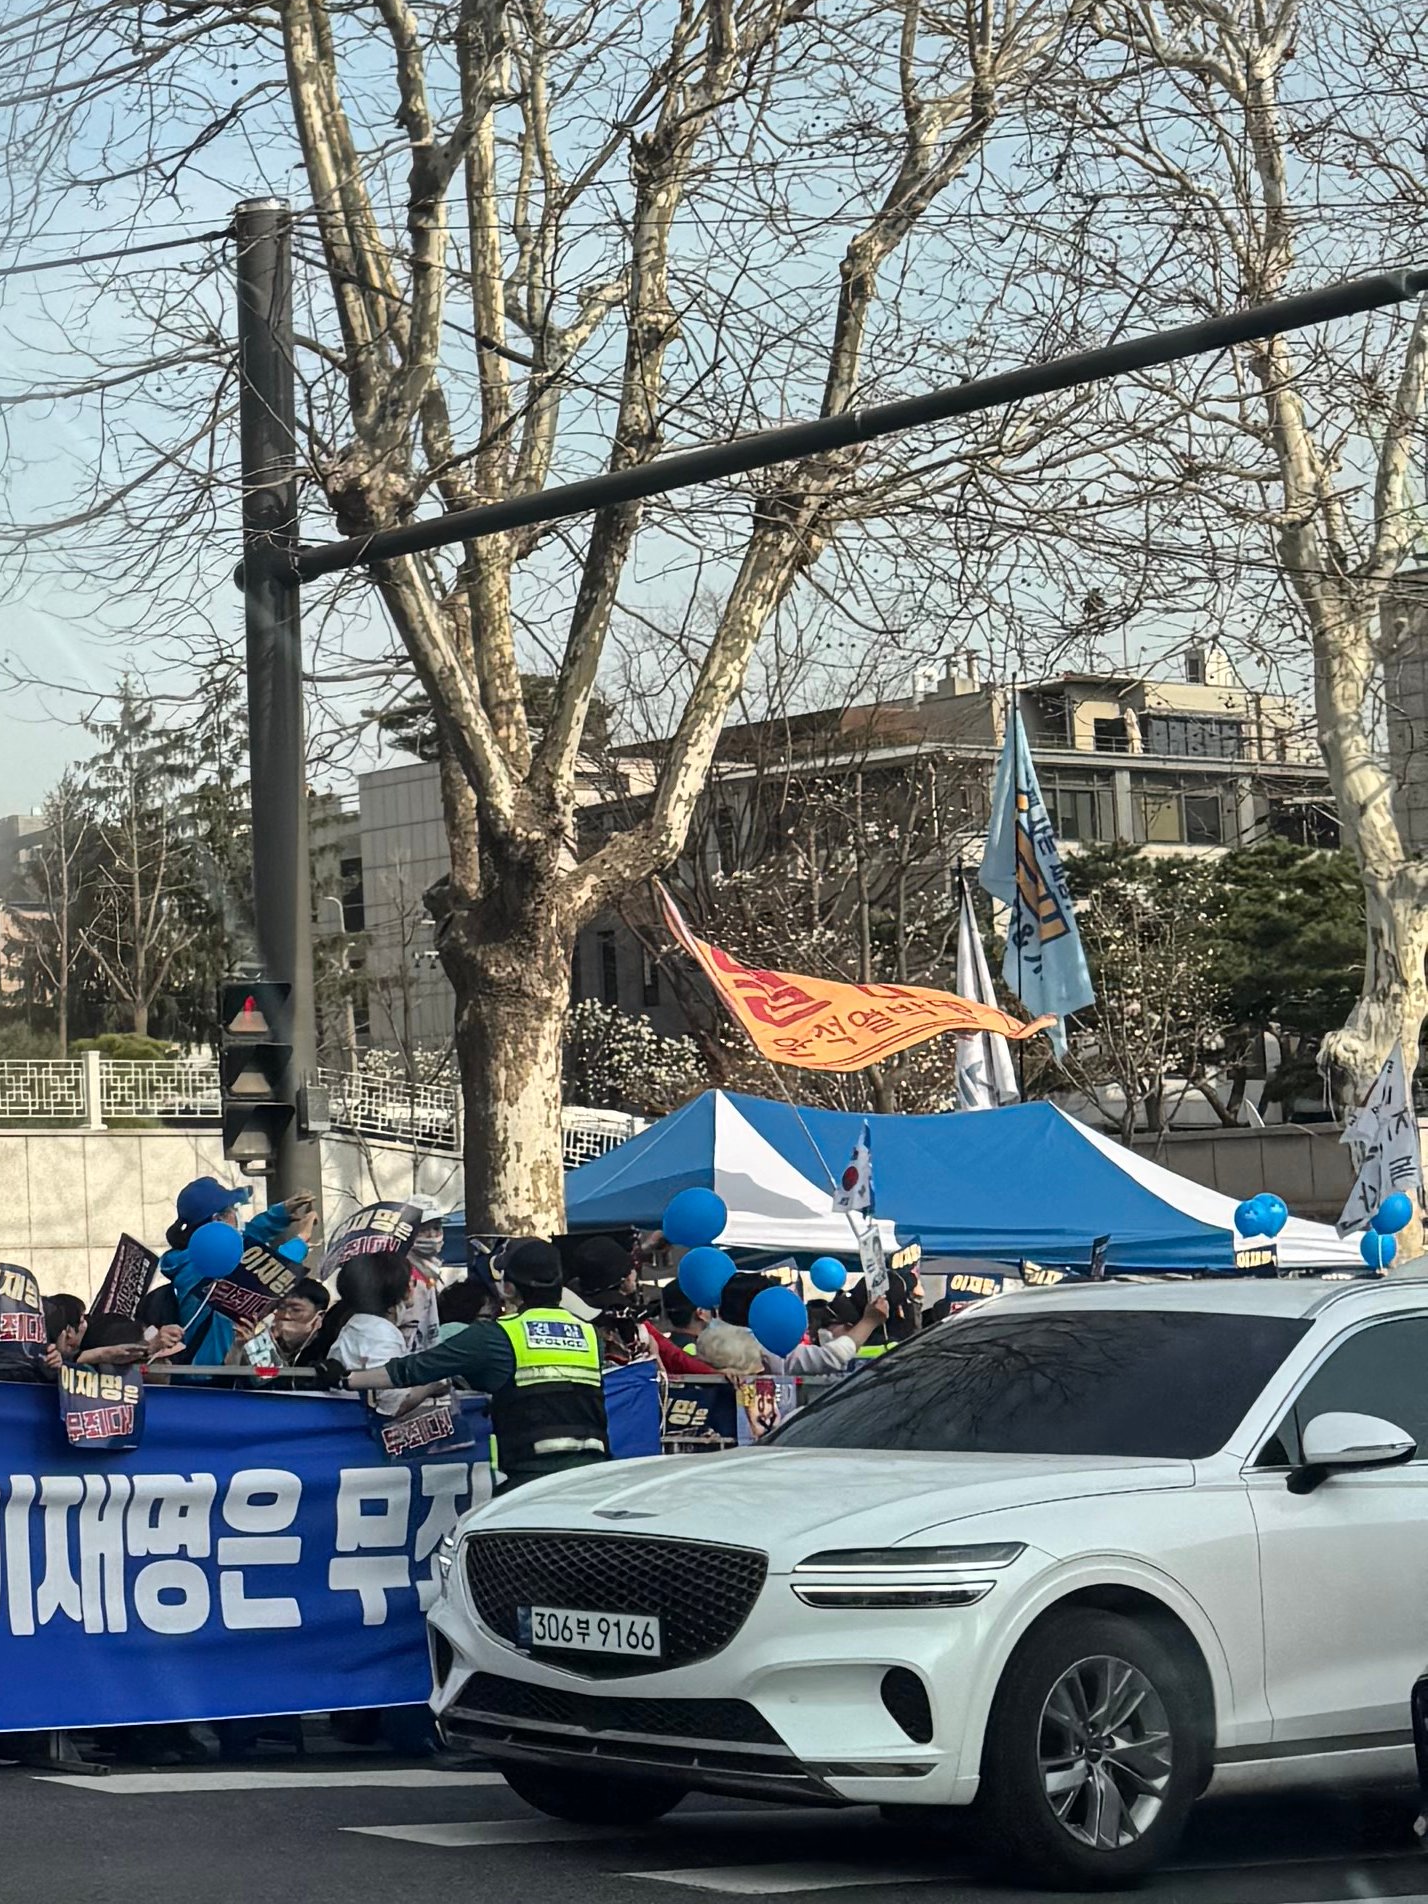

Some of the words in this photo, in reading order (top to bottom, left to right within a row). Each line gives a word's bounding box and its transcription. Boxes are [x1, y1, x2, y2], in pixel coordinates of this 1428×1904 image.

[61, 1365, 140, 1405] 이재명은
[534, 1612, 591, 1644] 306부
[597, 1617, 655, 1651] 9166
